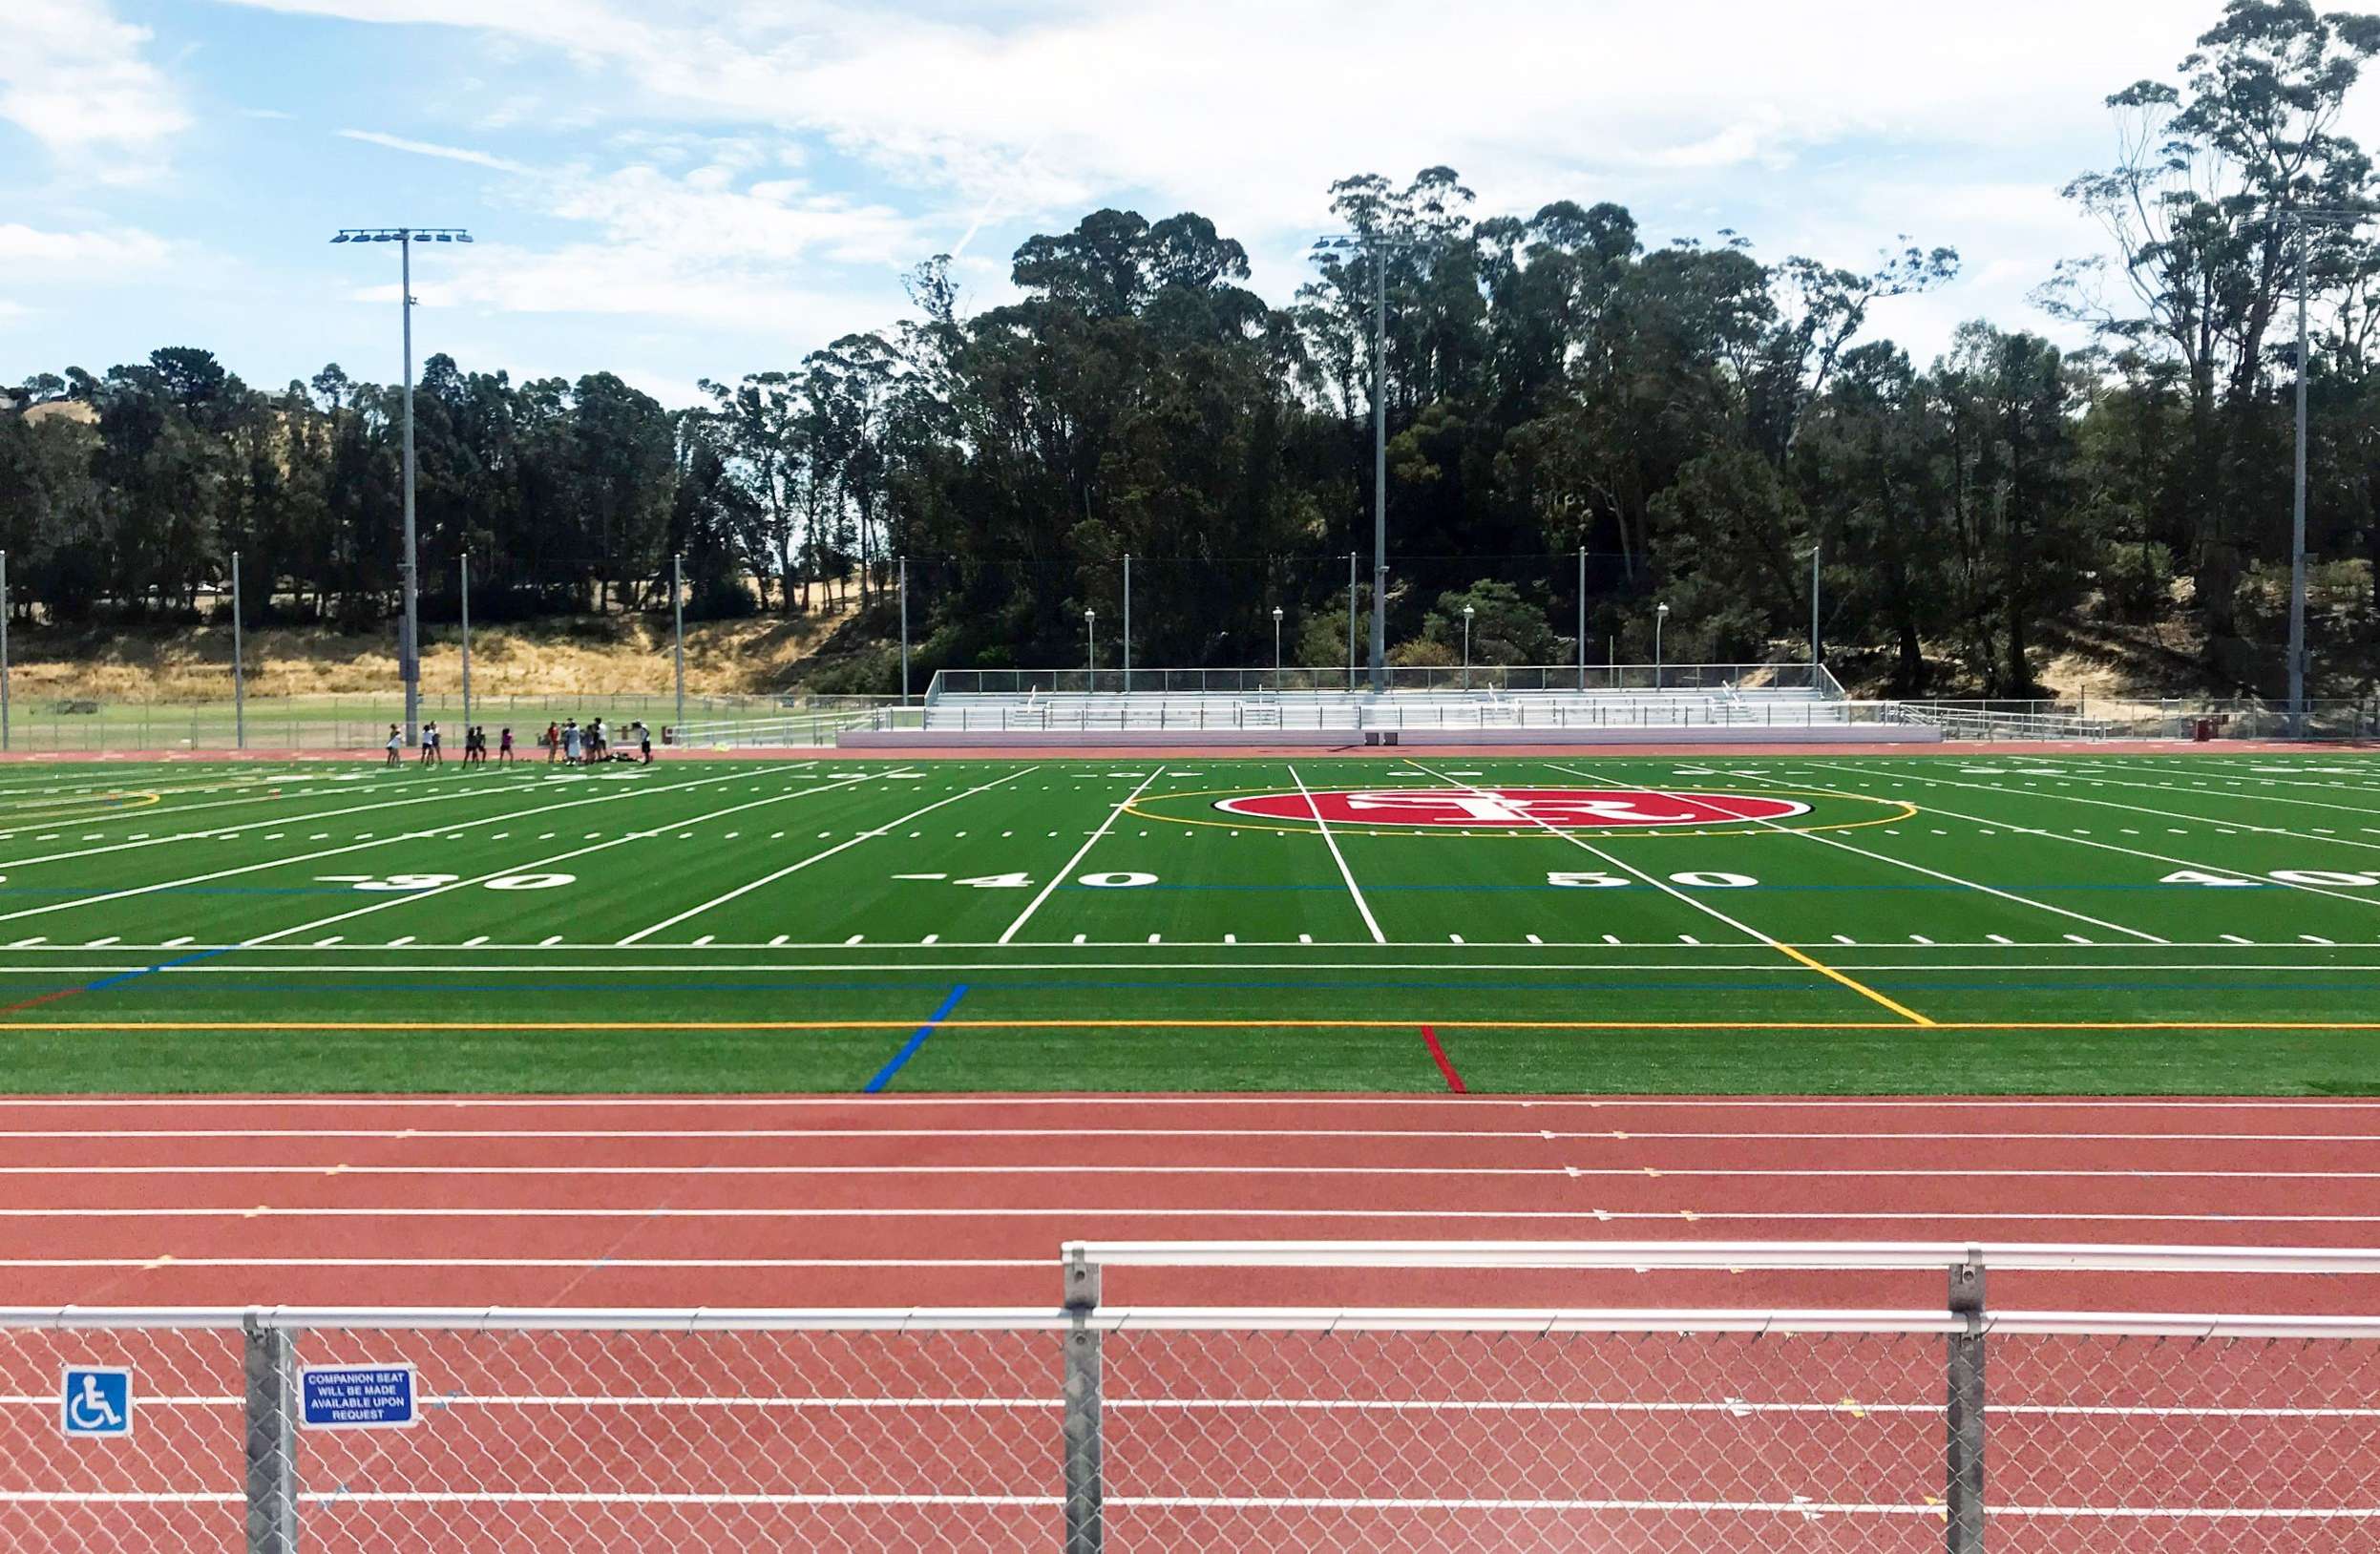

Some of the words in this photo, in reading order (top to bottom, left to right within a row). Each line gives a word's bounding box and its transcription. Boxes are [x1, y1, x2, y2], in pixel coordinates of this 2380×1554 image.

[308, 1373, 374, 1384] COMPANION
[376, 1372, 405, 1383] SEAT
[317, 1385, 345, 1396] WILL
[347, 1385, 362, 1396] BE
[364, 1385, 397, 1396] MADE
[310, 1397, 371, 1409] AVAILABLE
[372, 1396, 405, 1408] UPON
[331, 1409, 385, 1420] REQUEST
